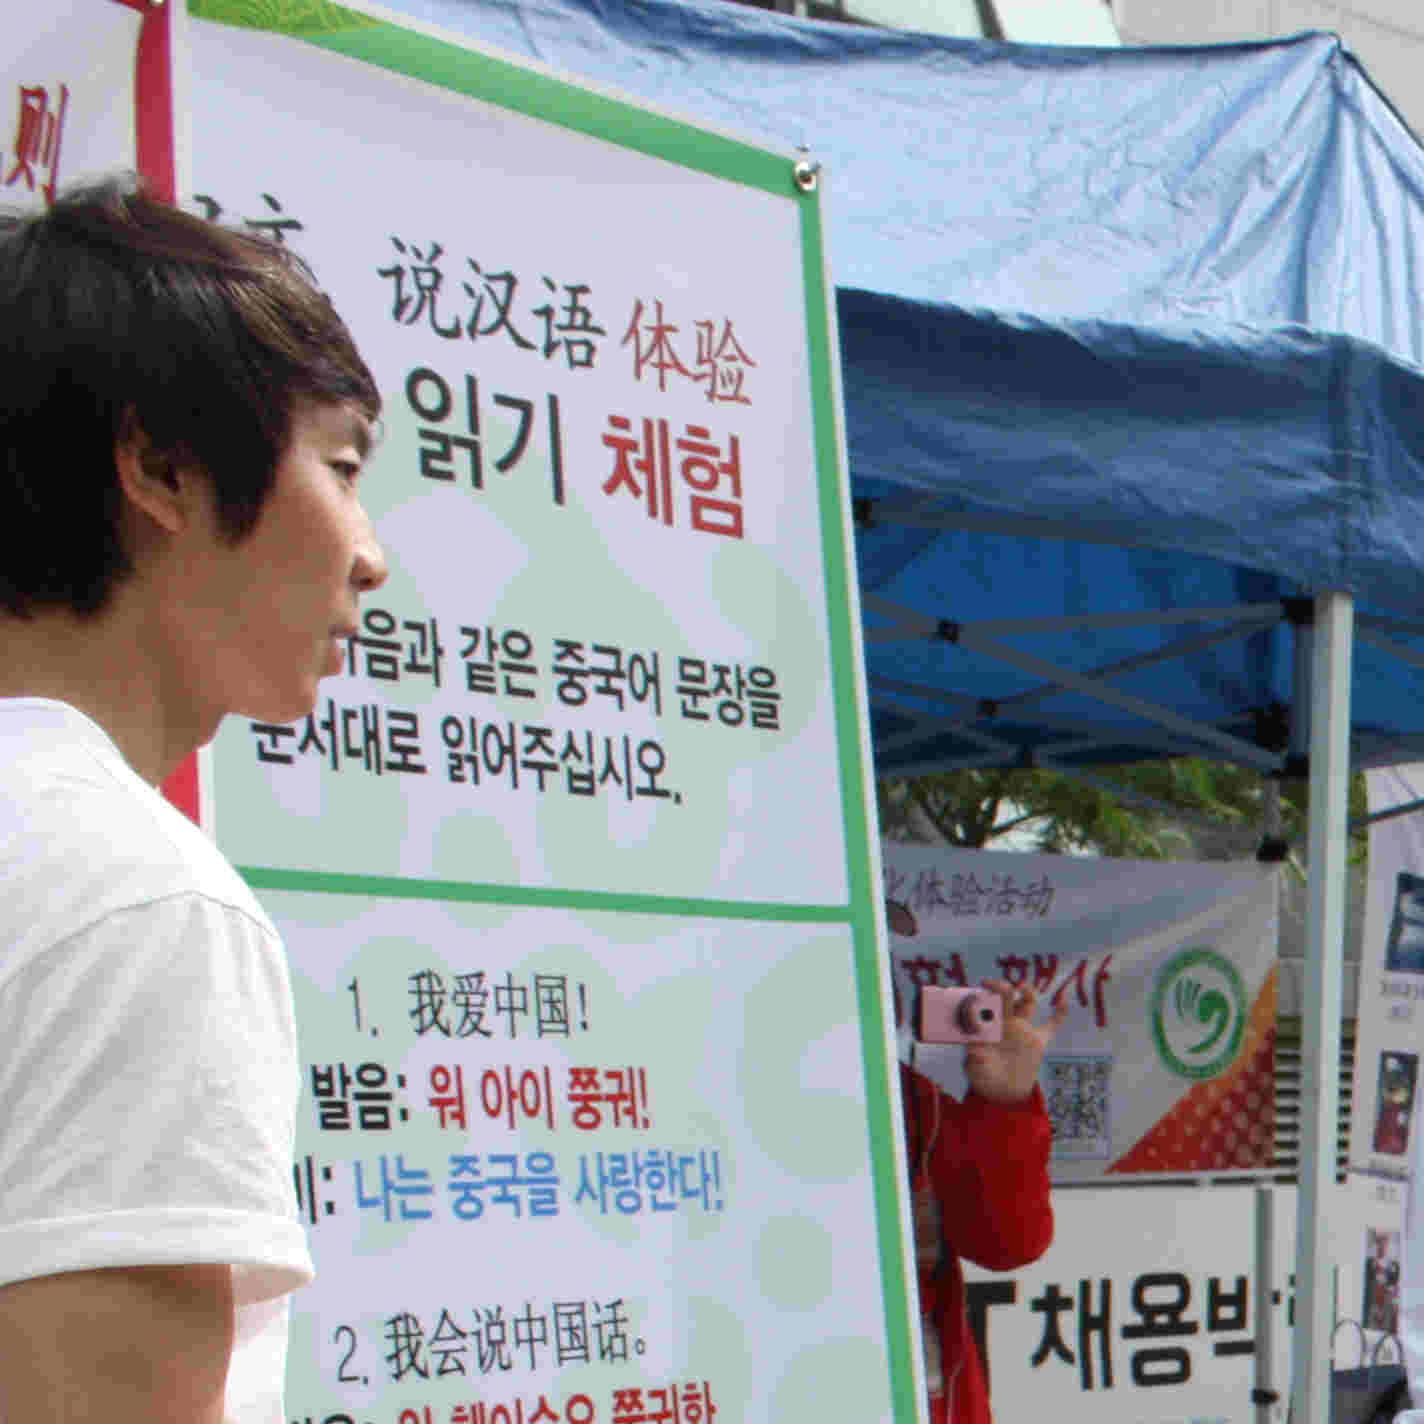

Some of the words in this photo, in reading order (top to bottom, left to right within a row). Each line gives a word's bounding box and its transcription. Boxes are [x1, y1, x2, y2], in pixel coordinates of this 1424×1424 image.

[376, 234, 607, 370] 说汉语
[621, 297, 759, 406] 体验
[405, 367, 566, 506] 읽기
[601, 414, 744, 539] 체험
[346, 608, 443, 688] 음과
[458, 625, 538, 699] 같은
[552, 638, 663, 716] 중국어
[676, 656, 781, 731] 문장을
[441, 715, 683, 805] 읽어주십시오.
[347, 976, 379, 1037] 1.
[407, 967, 589, 1040] 我爱中国!
[311, 1062, 409, 1131] 발음:
[428, 1065, 466, 1130] 워
[480, 1065, 555, 1130] 아이
[568, 1066, 650, 1130] 쭝궈!
[354, 1154, 434, 1224] 나는
[447, 1151, 560, 1221] 중국을
[574, 1148, 724, 1216] 사랑한다!
[334, 1325, 368, 1386] 2.
